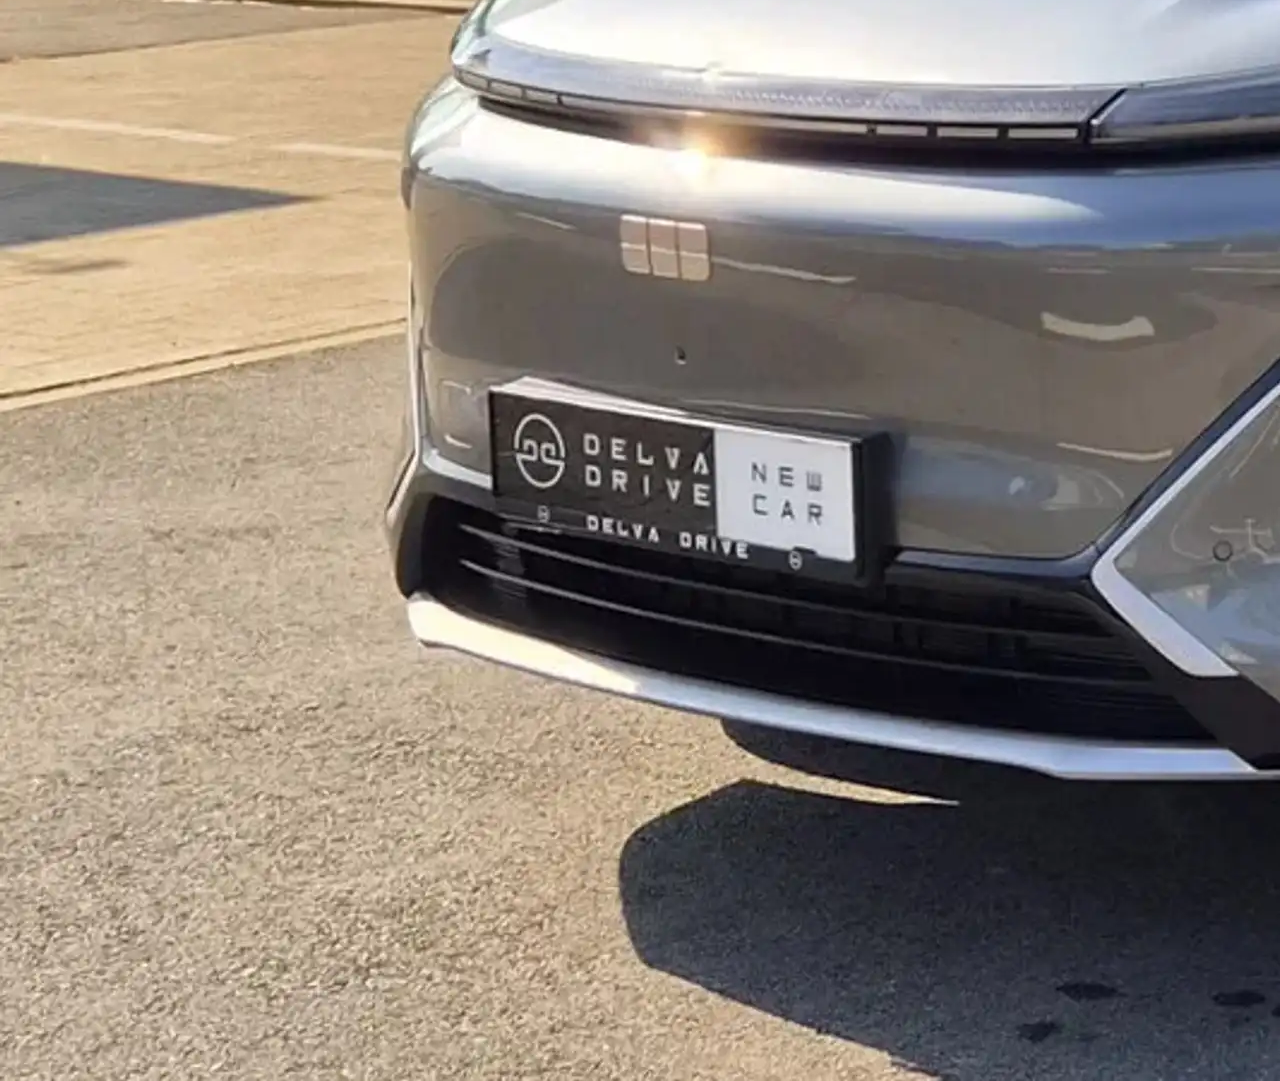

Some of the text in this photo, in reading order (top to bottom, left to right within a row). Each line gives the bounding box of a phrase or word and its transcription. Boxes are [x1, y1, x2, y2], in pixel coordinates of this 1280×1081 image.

[583, 433, 711, 475] DELVA
[584, 467, 711, 507] DRIVE
[751, 461, 823, 492] NEW
[752, 495, 823, 525] CAR
[586, 514, 750, 559] DELVA DRIVE
